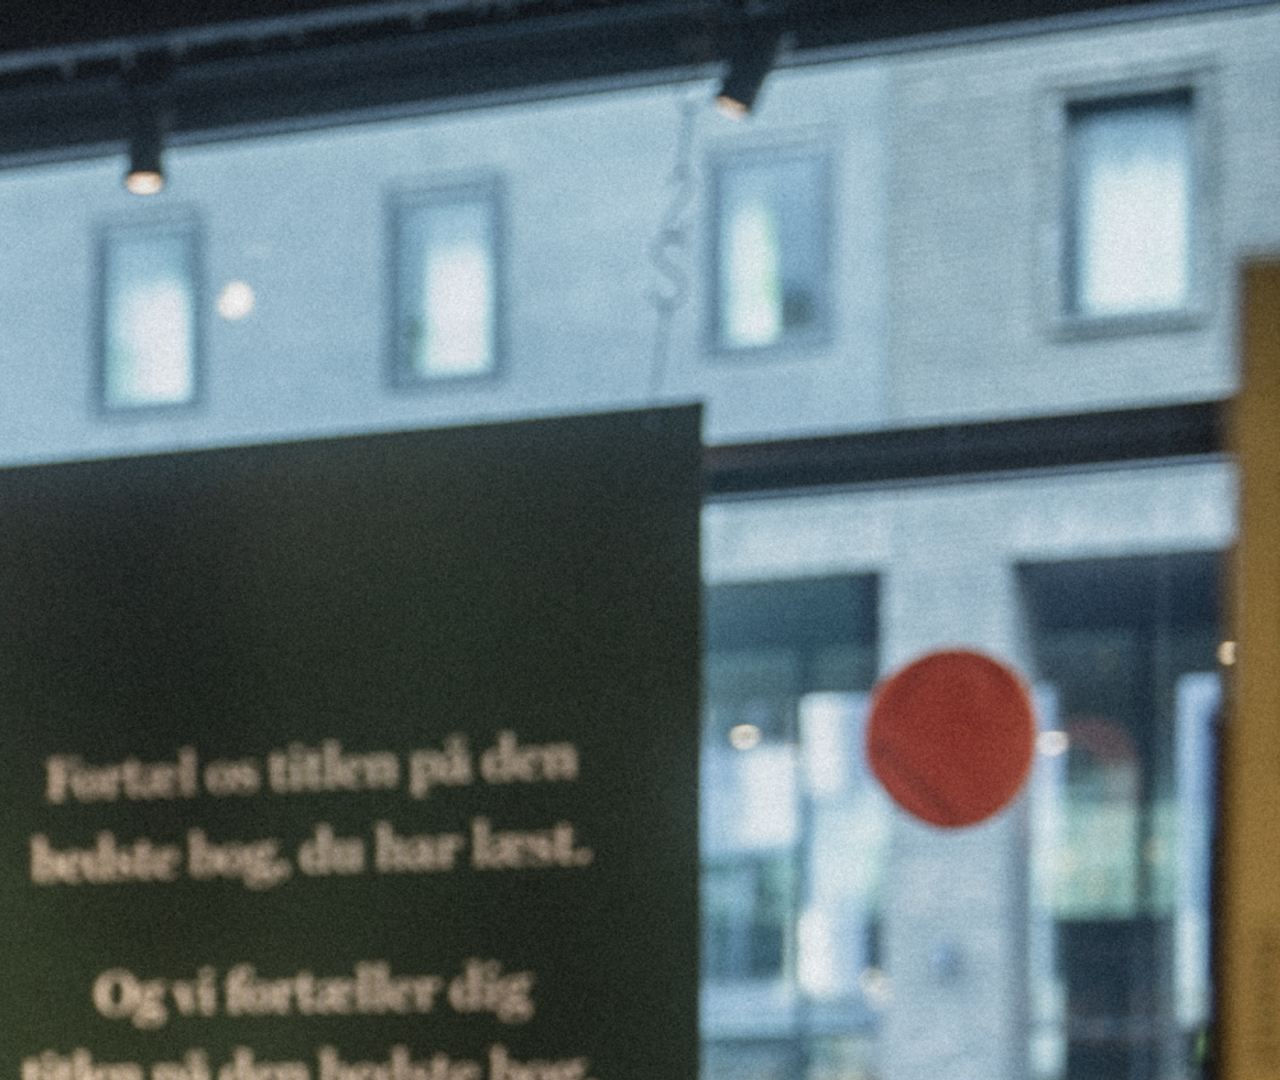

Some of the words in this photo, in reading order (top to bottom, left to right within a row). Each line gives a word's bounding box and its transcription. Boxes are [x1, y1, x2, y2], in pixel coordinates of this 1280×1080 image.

[45, 748, 197, 804] Fortæl
[204, 760, 261, 793] os
[267, 739, 401, 793] titlen
[408, 735, 473, 799] på
[479, 729, 580, 783] den
[29, 832, 179, 885] bedste
[187, 829, 292, 889] bog,
[296, 822, 366, 876] du
[374, 819, 463, 873] har
[470, 816, 592, 869] læst.
[91, 970, 168, 1028] Og
[171, 966, 218, 1017] vi
[223, 961, 438, 1017] fortæller
[446, 958, 534, 1022] dig
